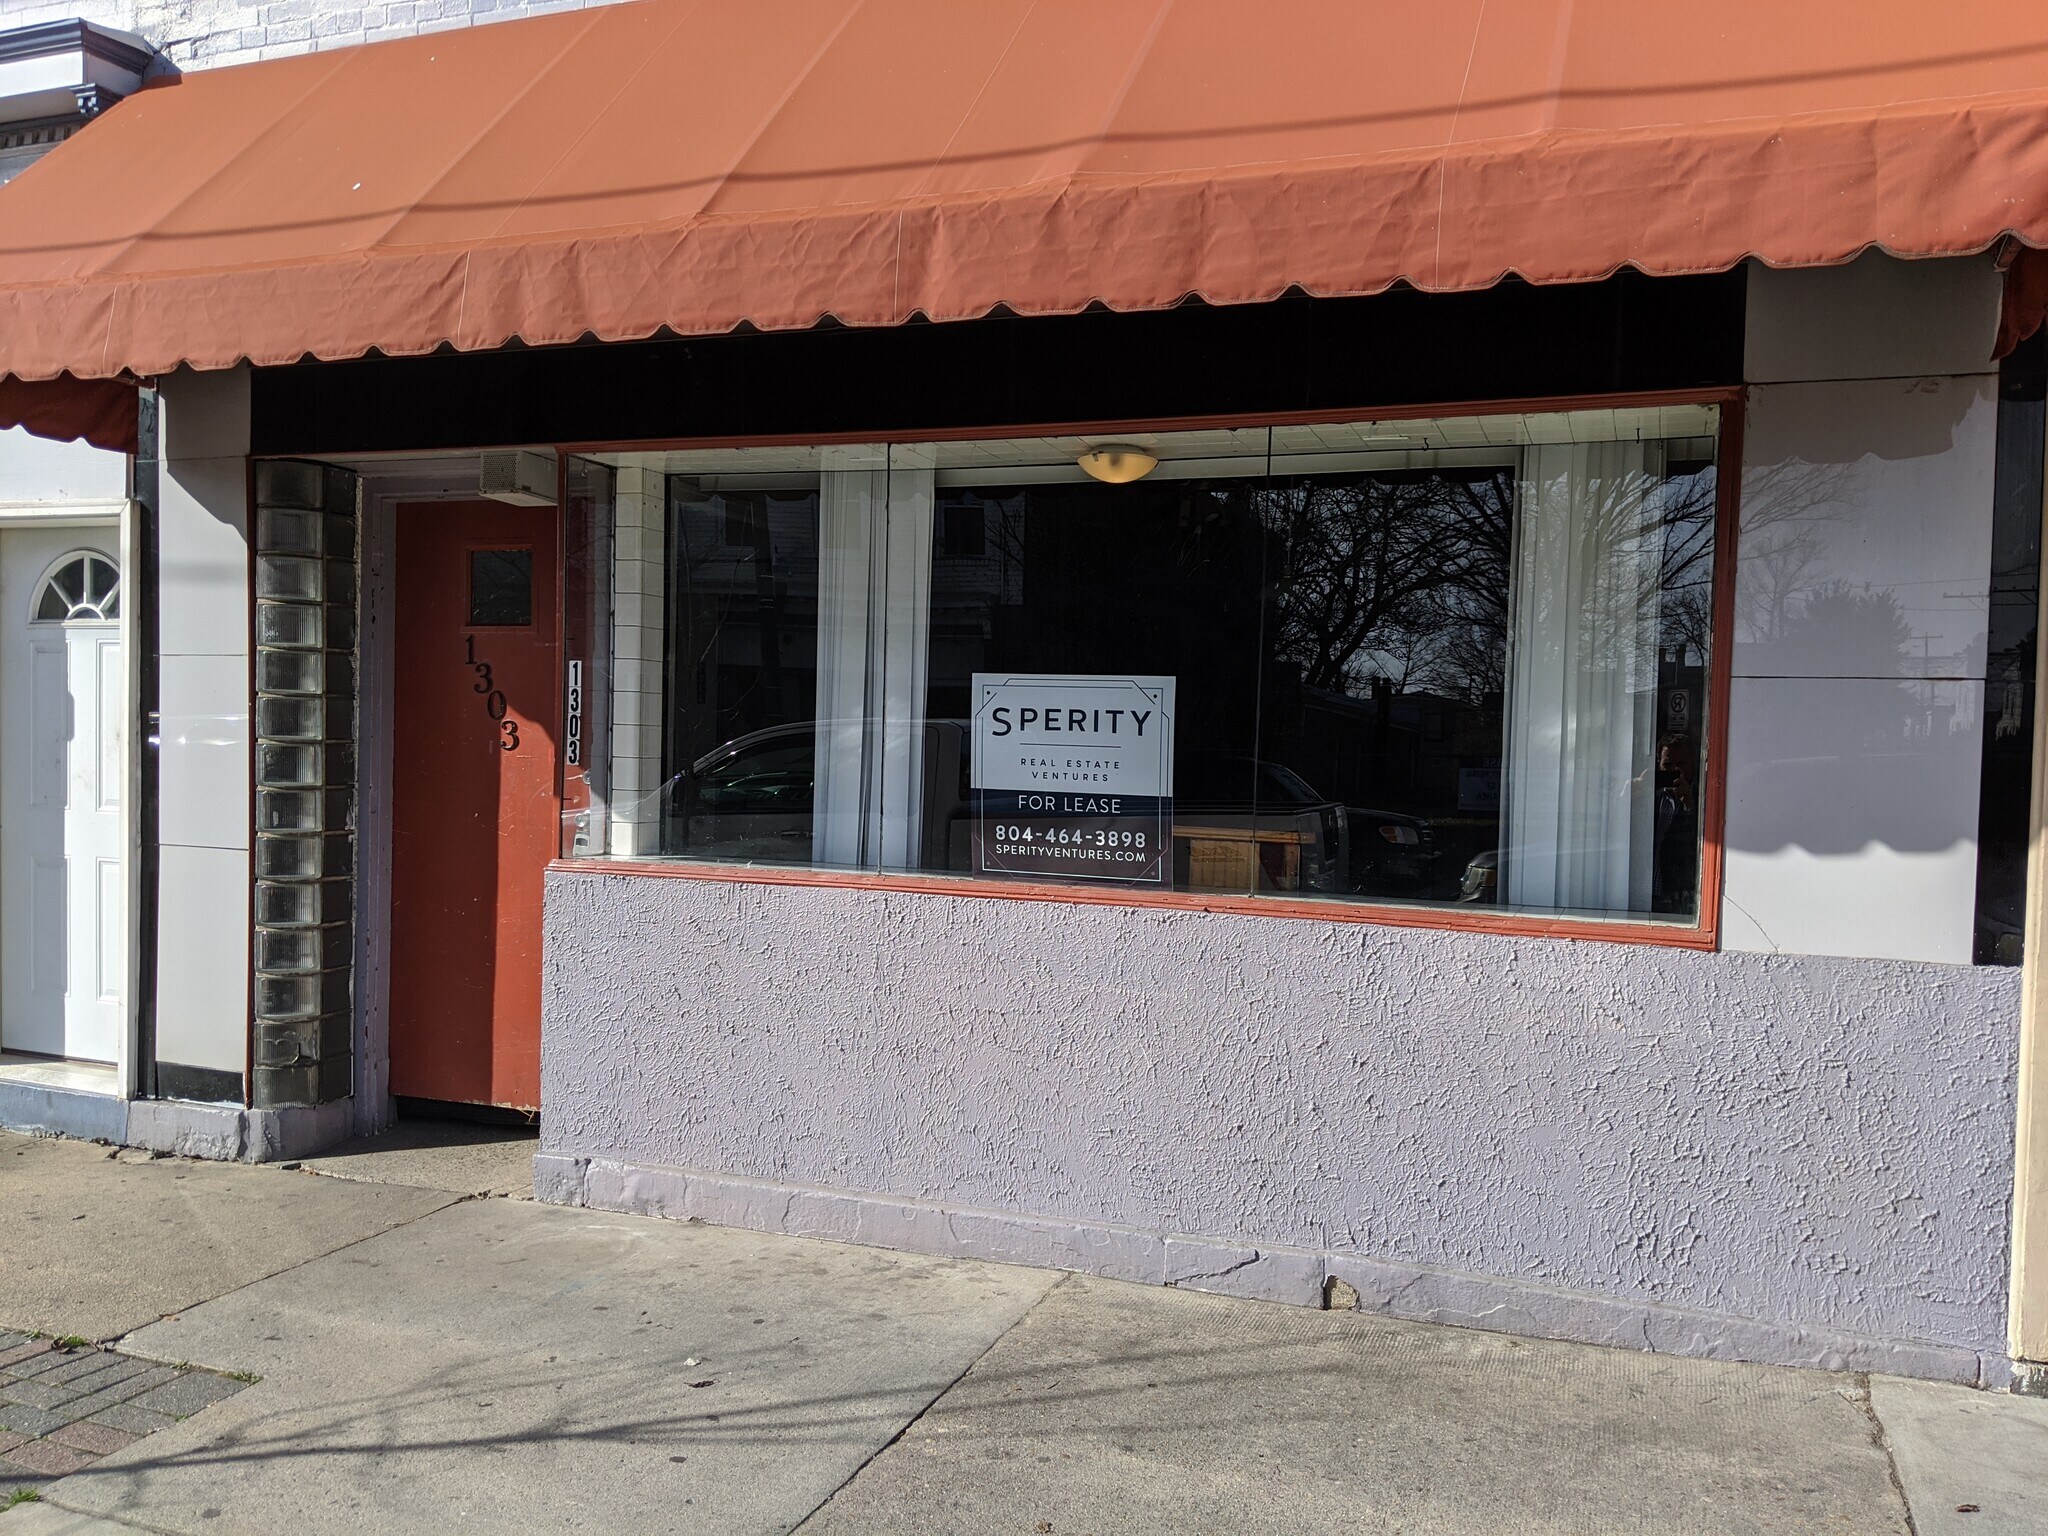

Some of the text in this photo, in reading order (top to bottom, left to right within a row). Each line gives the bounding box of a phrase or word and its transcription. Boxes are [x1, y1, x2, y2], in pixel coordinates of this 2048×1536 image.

[465, 634, 520, 751] 1303
[568, 661, 579, 764] 1303
[991, 707, 1152, 736] SPERITY
[1020, 758, 1120, 769] REAL ESTATE
[1031, 771, 1109, 782] VENTURES
[1018, 795, 1121, 814] FOR LEASE
[995, 825, 1146, 848] 804-464-3898
[995, 844, 1146, 862] SPERITYVENTURES.COM
